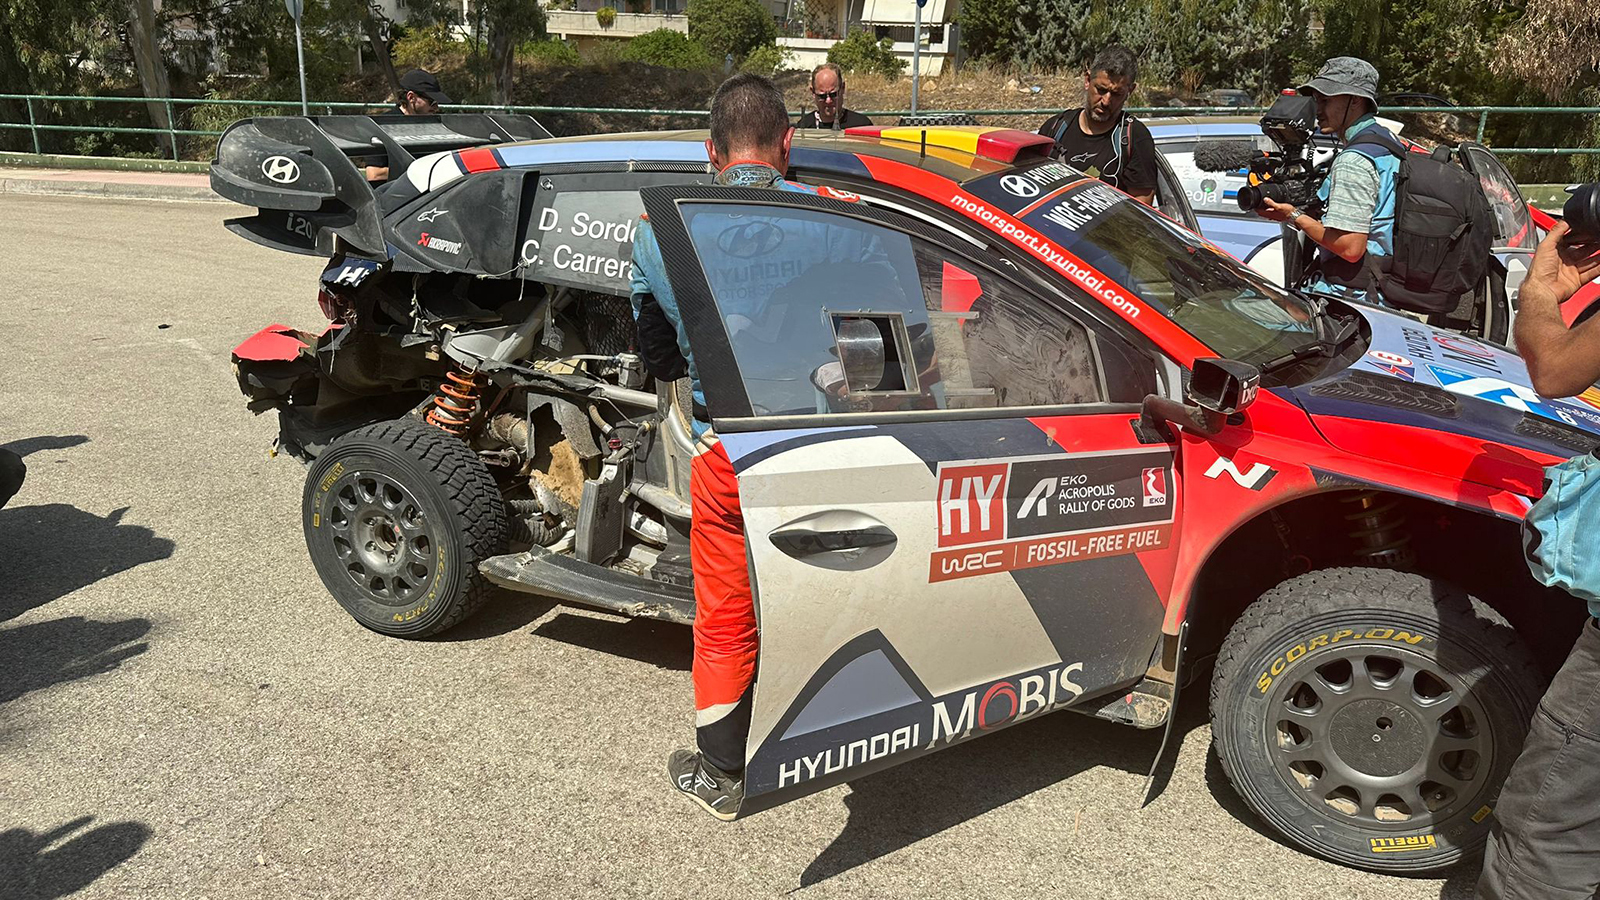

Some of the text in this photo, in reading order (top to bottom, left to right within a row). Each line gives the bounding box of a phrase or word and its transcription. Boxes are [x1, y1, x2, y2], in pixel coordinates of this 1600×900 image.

[286, 212, 313, 240] i20
[538, 207, 562, 234] D.
[521, 239, 544, 265] C.
[951, 195, 1140, 318] motorsport.hyundai.com
[1058, 484, 1115, 500] ACROPOLIS
[1060, 474, 1088, 486] EKO
[941, 474, 1003, 536] HY
[1059, 497, 1135, 514] RALLY OF GODS
[1149, 496, 1165, 504] EKO
[1027, 529, 1162, 563] FOSSIL-FREE FUEL
[941, 550, 1003, 575] WRC
[1256, 628, 1425, 694] SCORPION
[778, 662, 1088, 789] HYUNDAI MOBIS
[1370, 834, 1438, 853] PIRELLI
